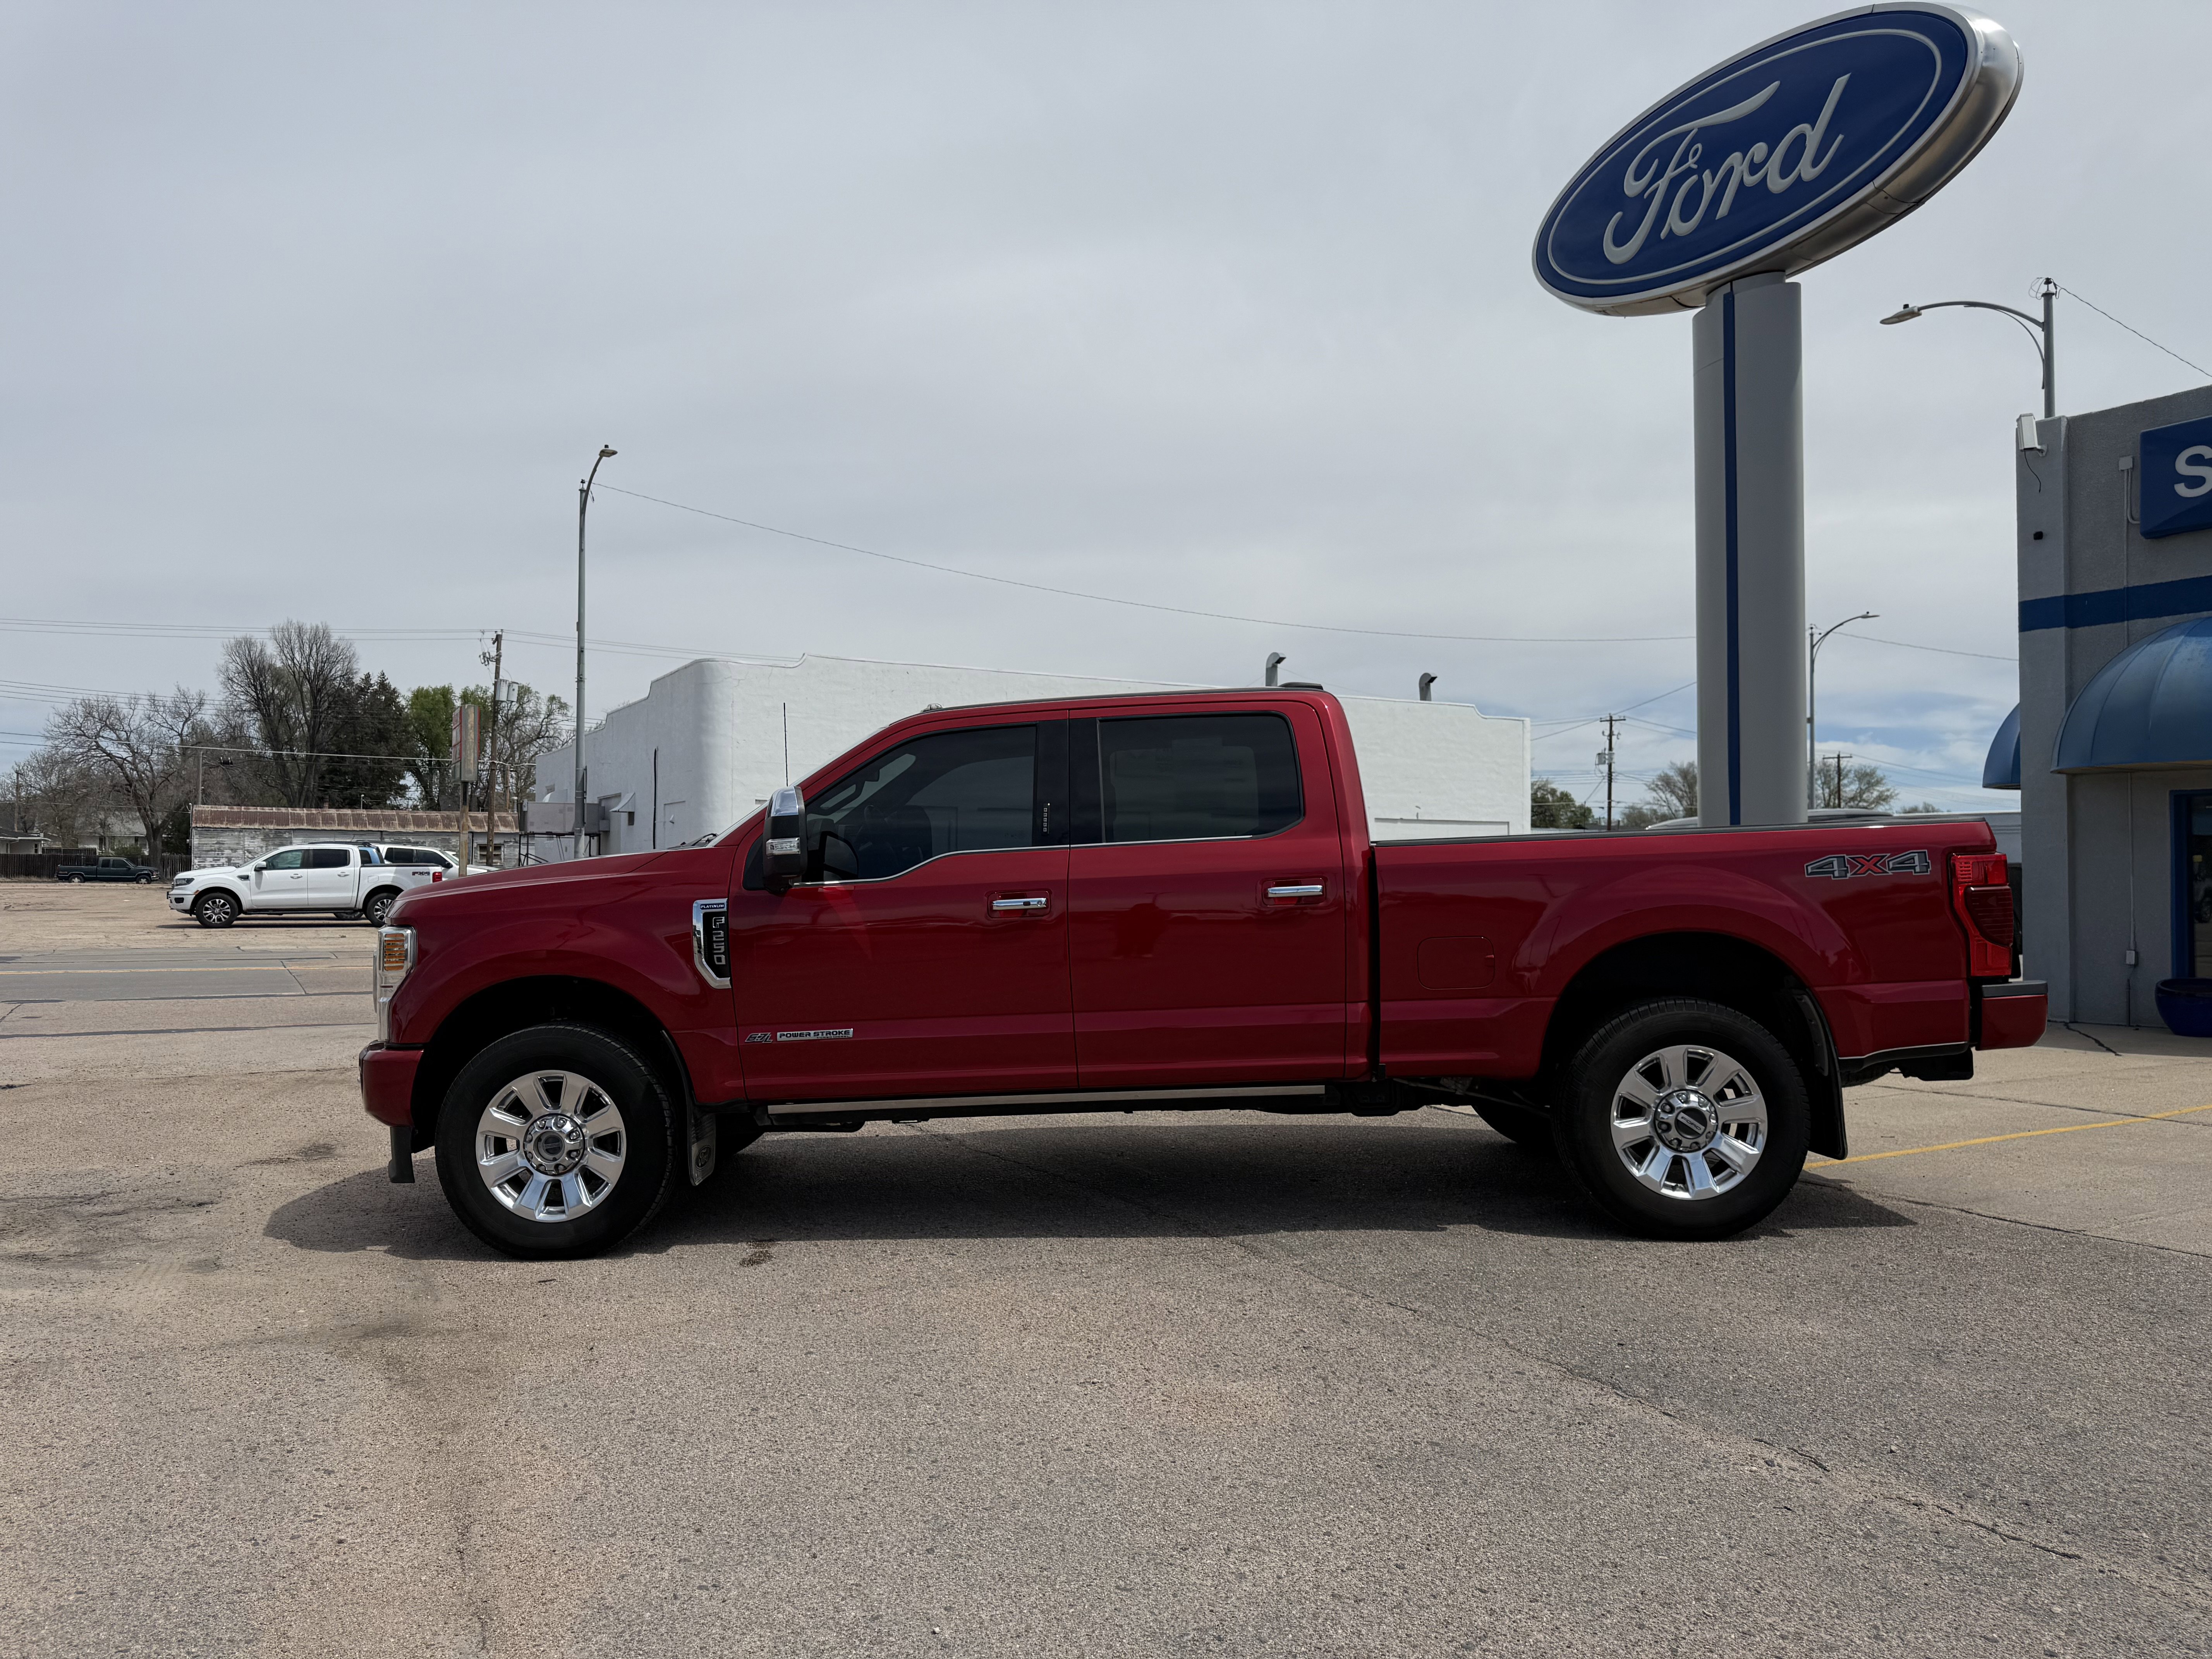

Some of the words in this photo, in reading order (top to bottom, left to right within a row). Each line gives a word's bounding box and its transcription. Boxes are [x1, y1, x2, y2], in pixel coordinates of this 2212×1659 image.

[1602, 72, 1851, 264] Ford
[744, 1032, 773, 1043] 6.7L
[1681, 1116, 1701, 1130] FORD
